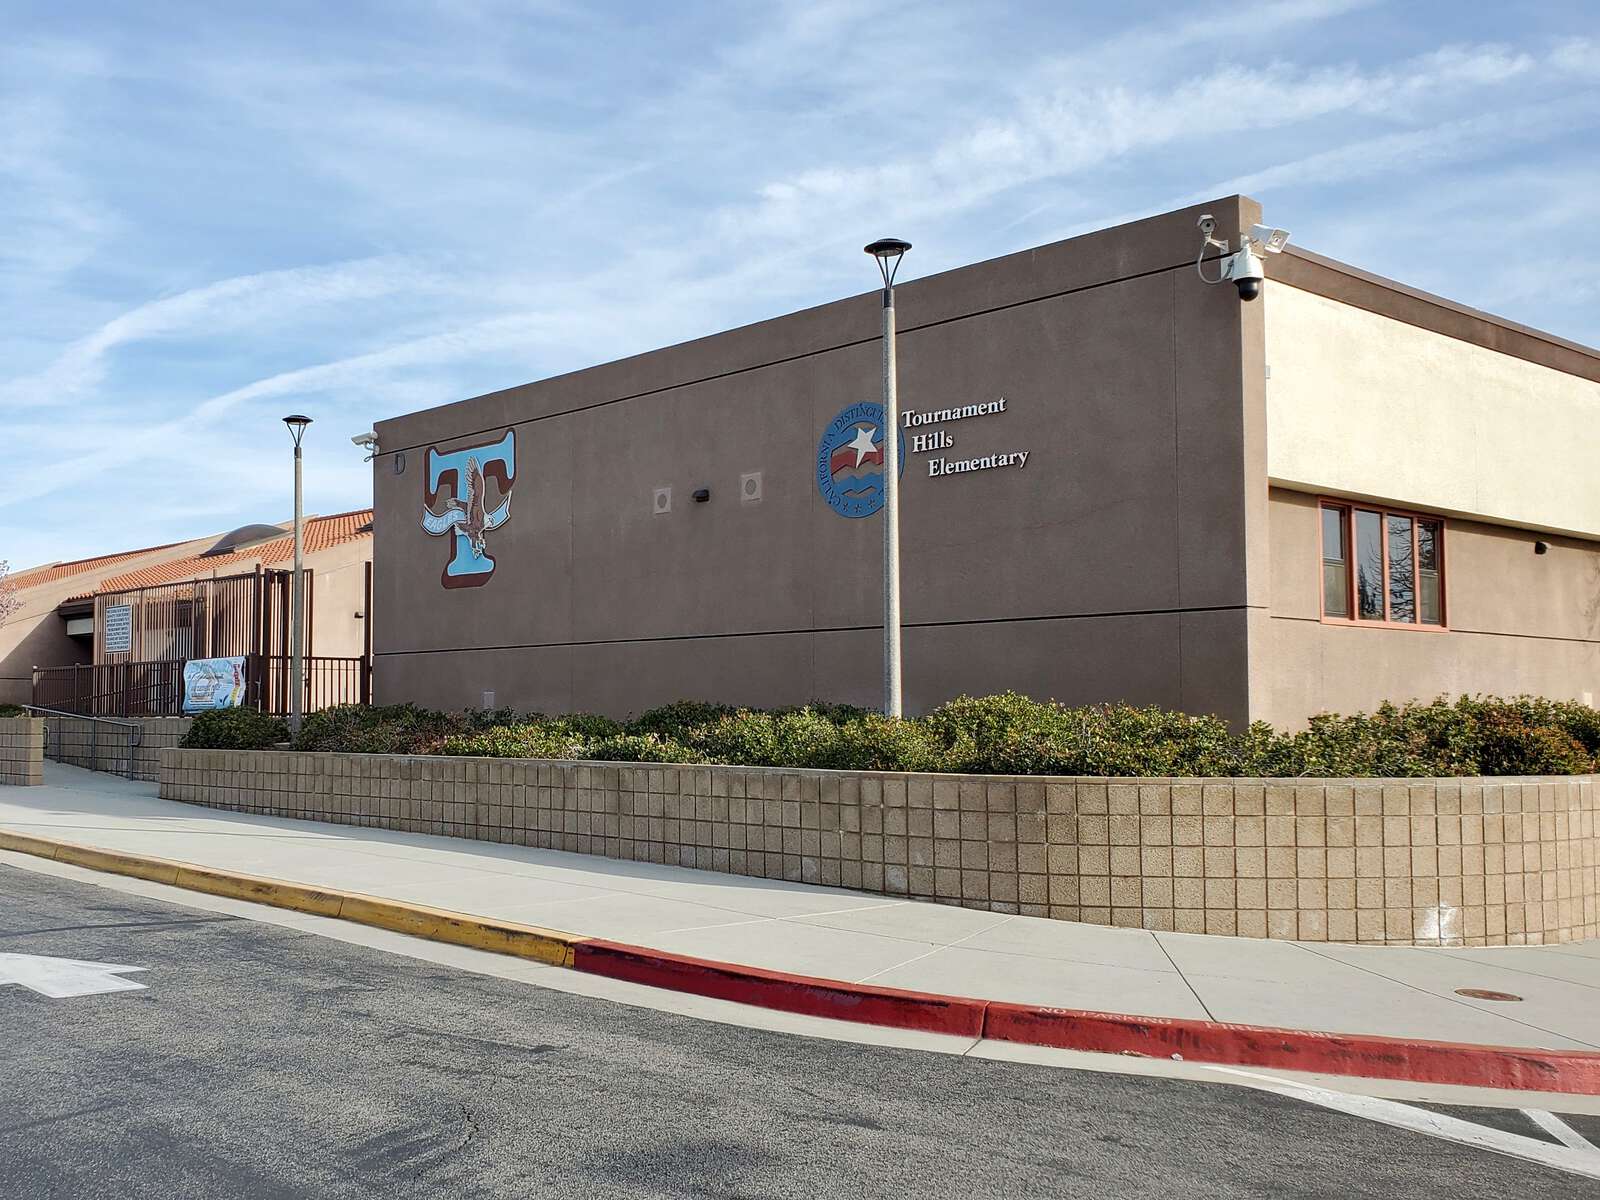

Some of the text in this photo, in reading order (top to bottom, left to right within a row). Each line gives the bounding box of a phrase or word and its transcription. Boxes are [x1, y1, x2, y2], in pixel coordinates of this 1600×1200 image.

[901, 397, 1007, 428] Tournament
[912, 430, 954, 453] Hills
[928, 451, 1030, 477] Elementary
[1039, 1007, 1066, 1015] NO
[1082, 1011, 1172, 1025] PARKING
